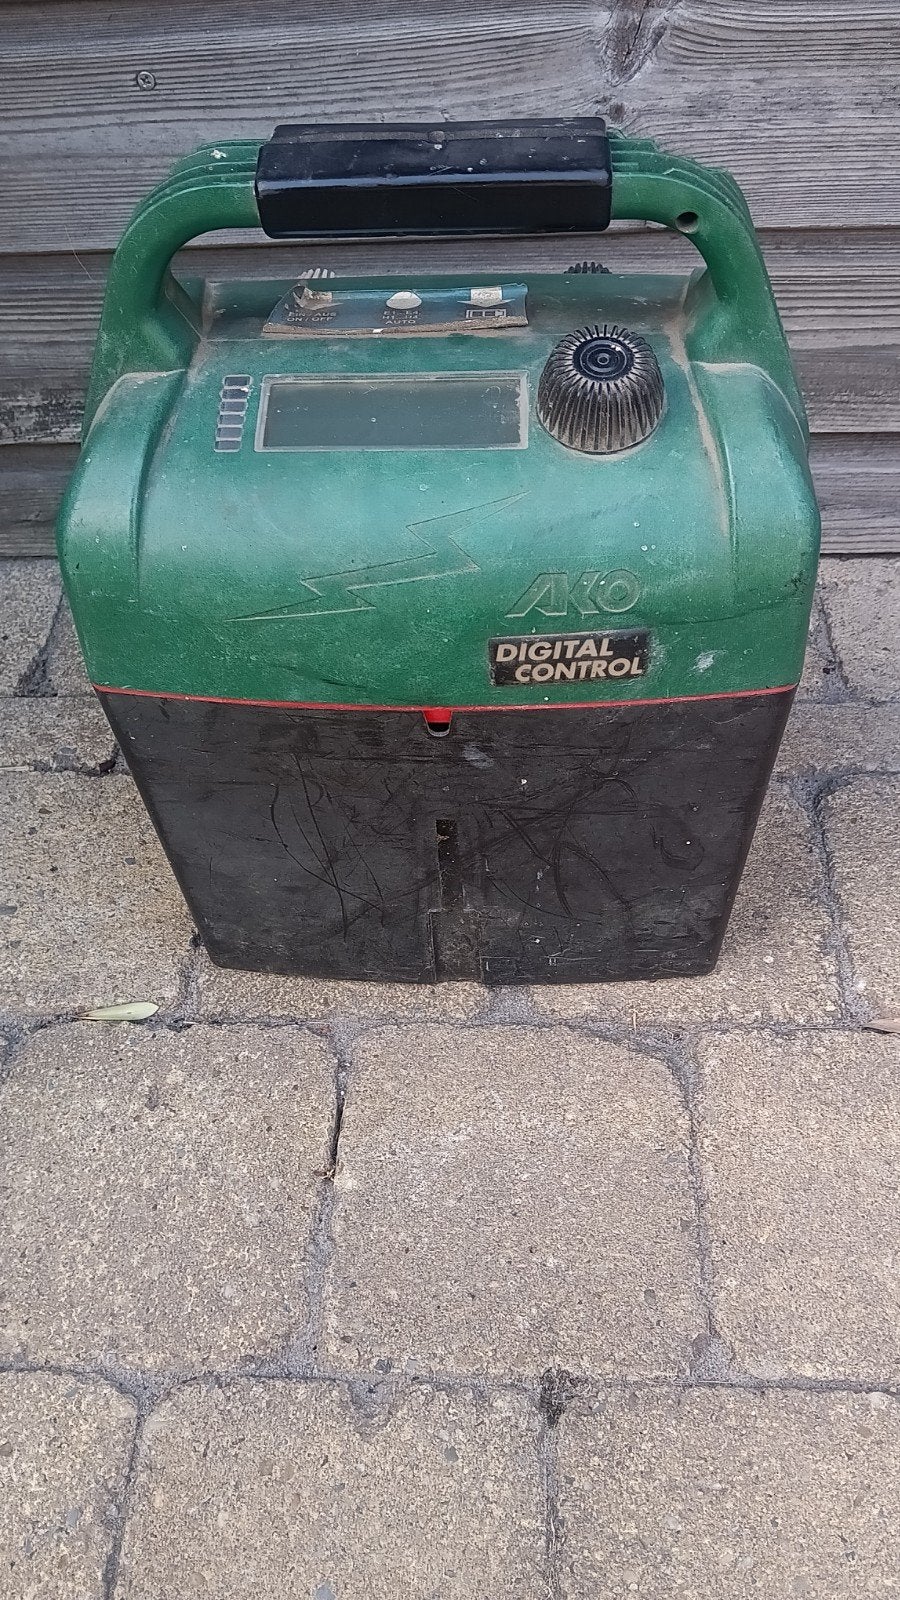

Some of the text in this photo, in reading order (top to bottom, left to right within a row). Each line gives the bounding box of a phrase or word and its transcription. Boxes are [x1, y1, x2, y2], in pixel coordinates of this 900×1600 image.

[504, 569, 641, 618] AKO
[495, 638, 614, 661] DIGITAL
[514, 657, 644, 683] CONTROL
